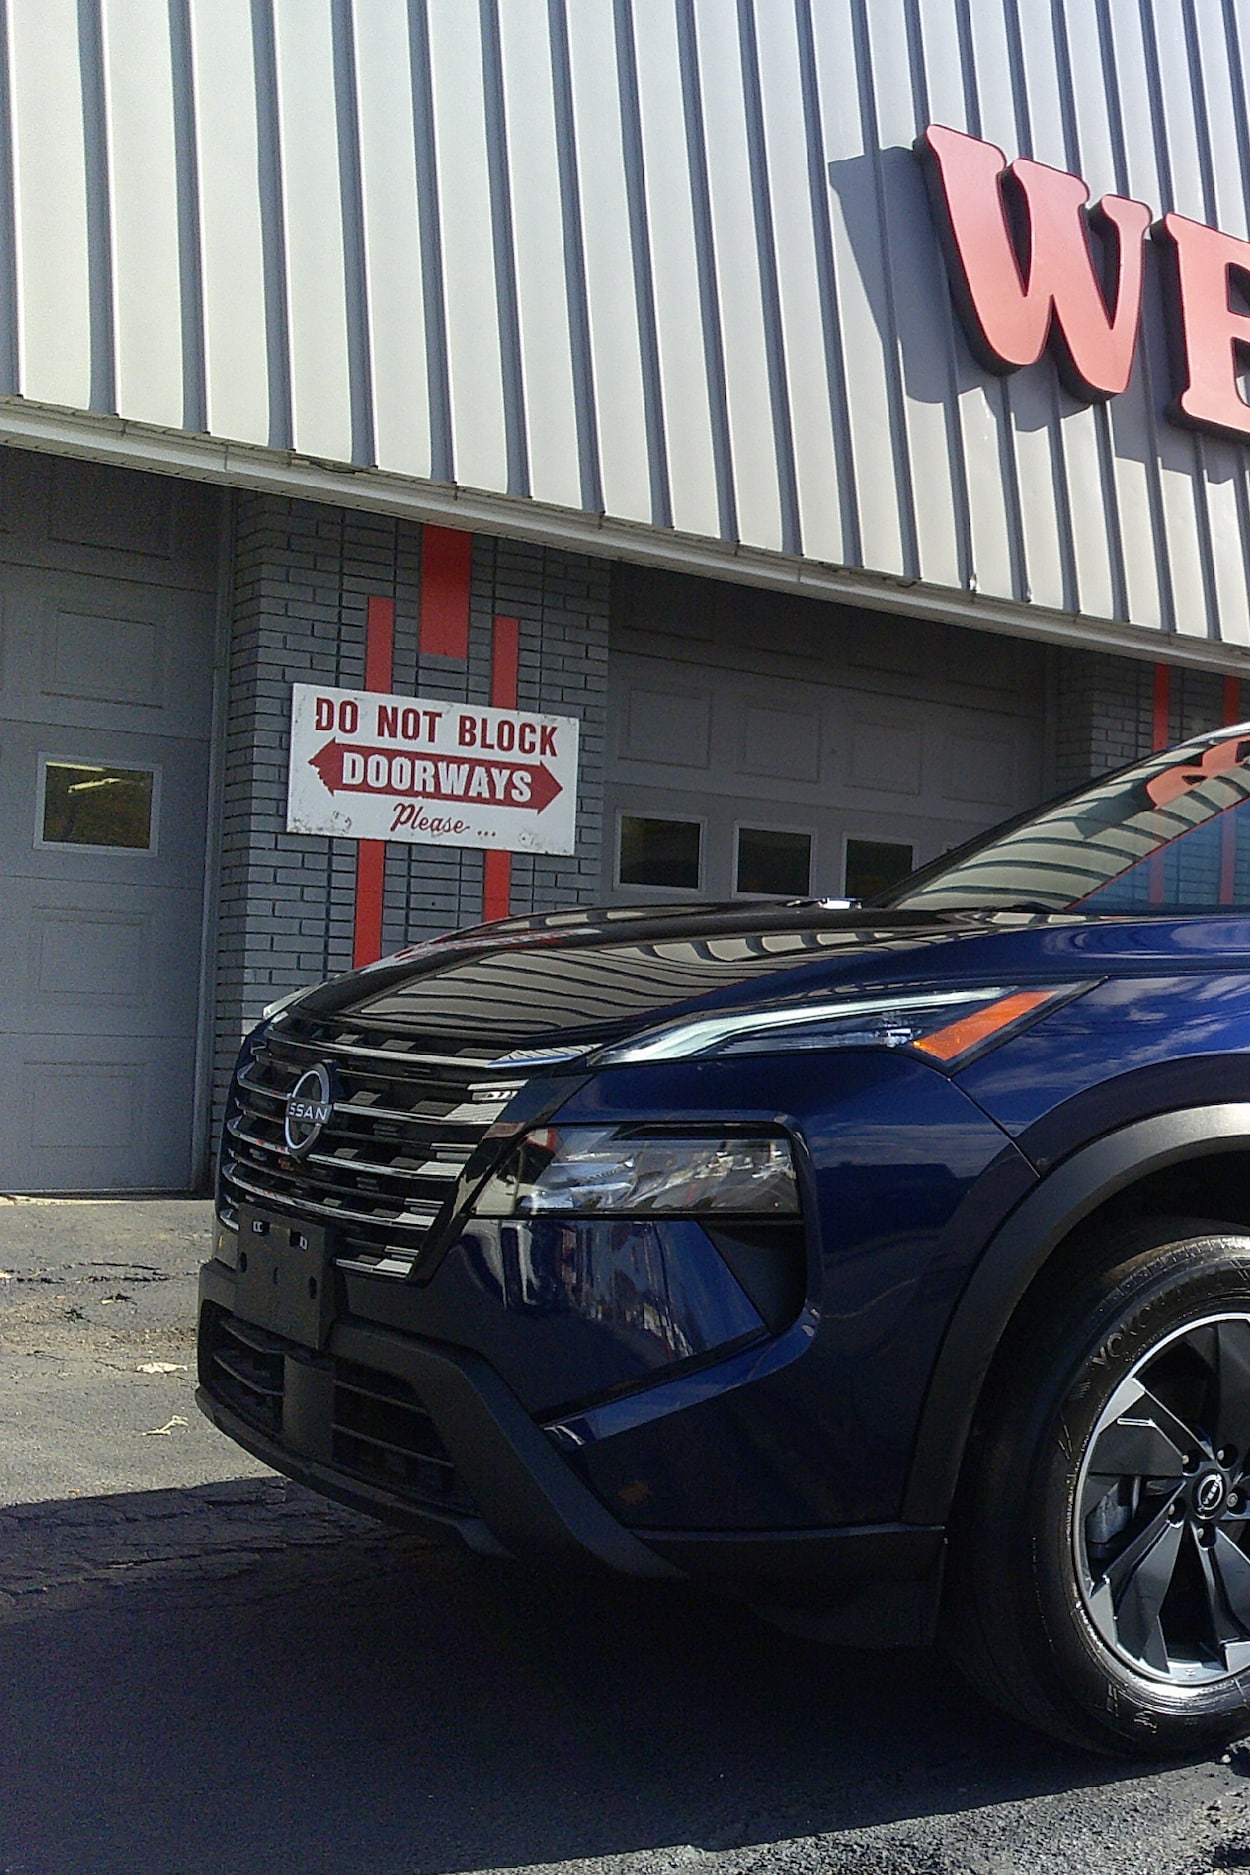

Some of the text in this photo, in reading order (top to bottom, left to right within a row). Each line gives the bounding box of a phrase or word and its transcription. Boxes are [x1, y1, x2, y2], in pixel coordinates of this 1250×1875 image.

[315, 697, 559, 757] DO NOT BLOCK
[342, 752, 533, 803] DOORWAYS
[390, 802, 471, 834] Please
